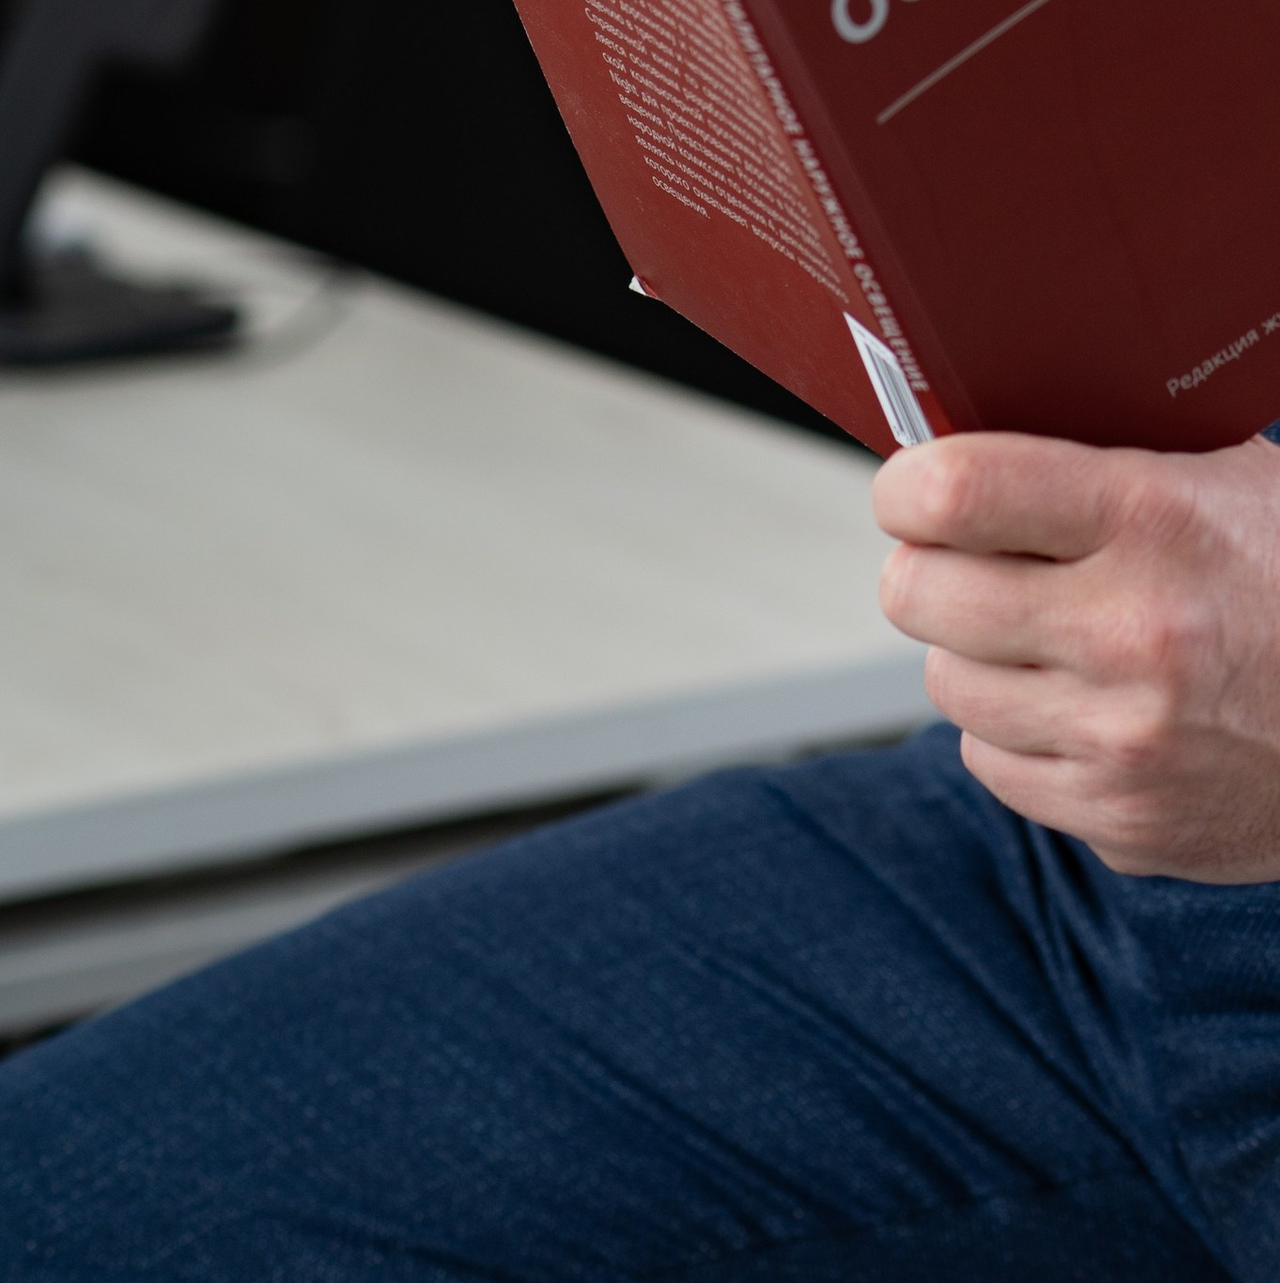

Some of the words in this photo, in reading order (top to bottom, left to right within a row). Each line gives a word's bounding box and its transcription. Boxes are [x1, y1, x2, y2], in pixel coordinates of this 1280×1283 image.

[583, 6, 649, 57] Справочной
[593, 30, 627, 57] ляется
[602, 52, 627, 72] ской
[609, 69, 640, 98] Night
[639, 90, 660, 110] для
[618, 91, 666, 129] вещения.
[627, 114, 677, 151] народной
[677, 145, 728, 185] комиссии
[635, 135, 675, 165] являясь
[674, 158, 715, 191] членом
[644, 157, 691, 192] которого
[691, 185, 751, 231] охватывает
[652, 176, 711, 220] освещения.
[793, 137, 865, 260] НАРУЖНОЕ
[853, 261, 932, 393] ОСВЕЩЕНИЕ
[1165, 329, 1260, 398] Редакция
